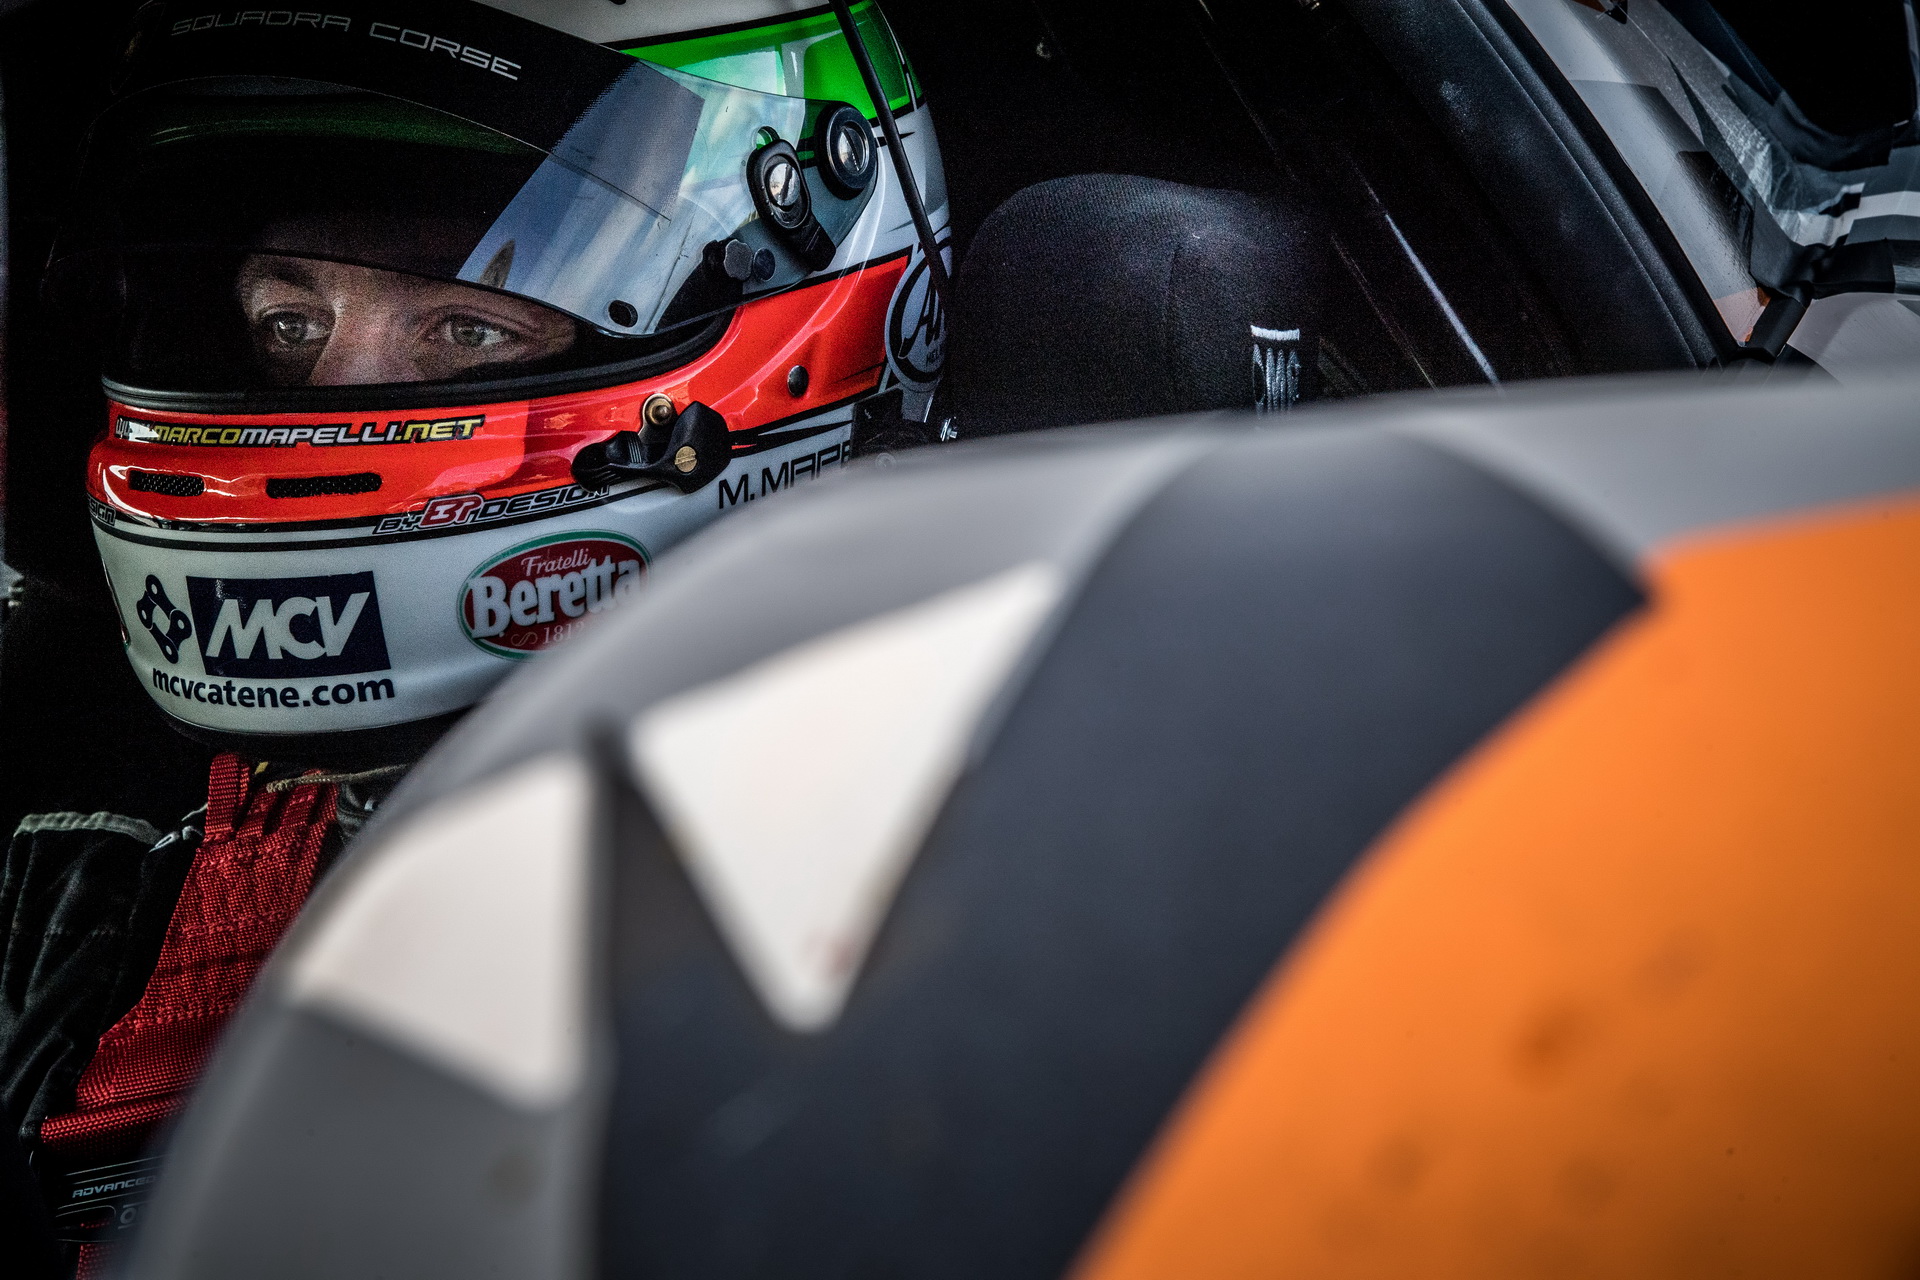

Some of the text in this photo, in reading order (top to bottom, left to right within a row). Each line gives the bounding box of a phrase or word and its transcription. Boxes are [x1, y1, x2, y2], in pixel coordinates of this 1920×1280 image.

[171, 10, 522, 81] SQUADRA CORSE
[520, 548, 591, 577] Fratelli
[468, 555, 643, 640] Beretta
[205, 591, 371, 660] MCV
[152, 667, 396, 708] mcvcatene.com
[71, 1175, 156, 1198] ADVANCED
